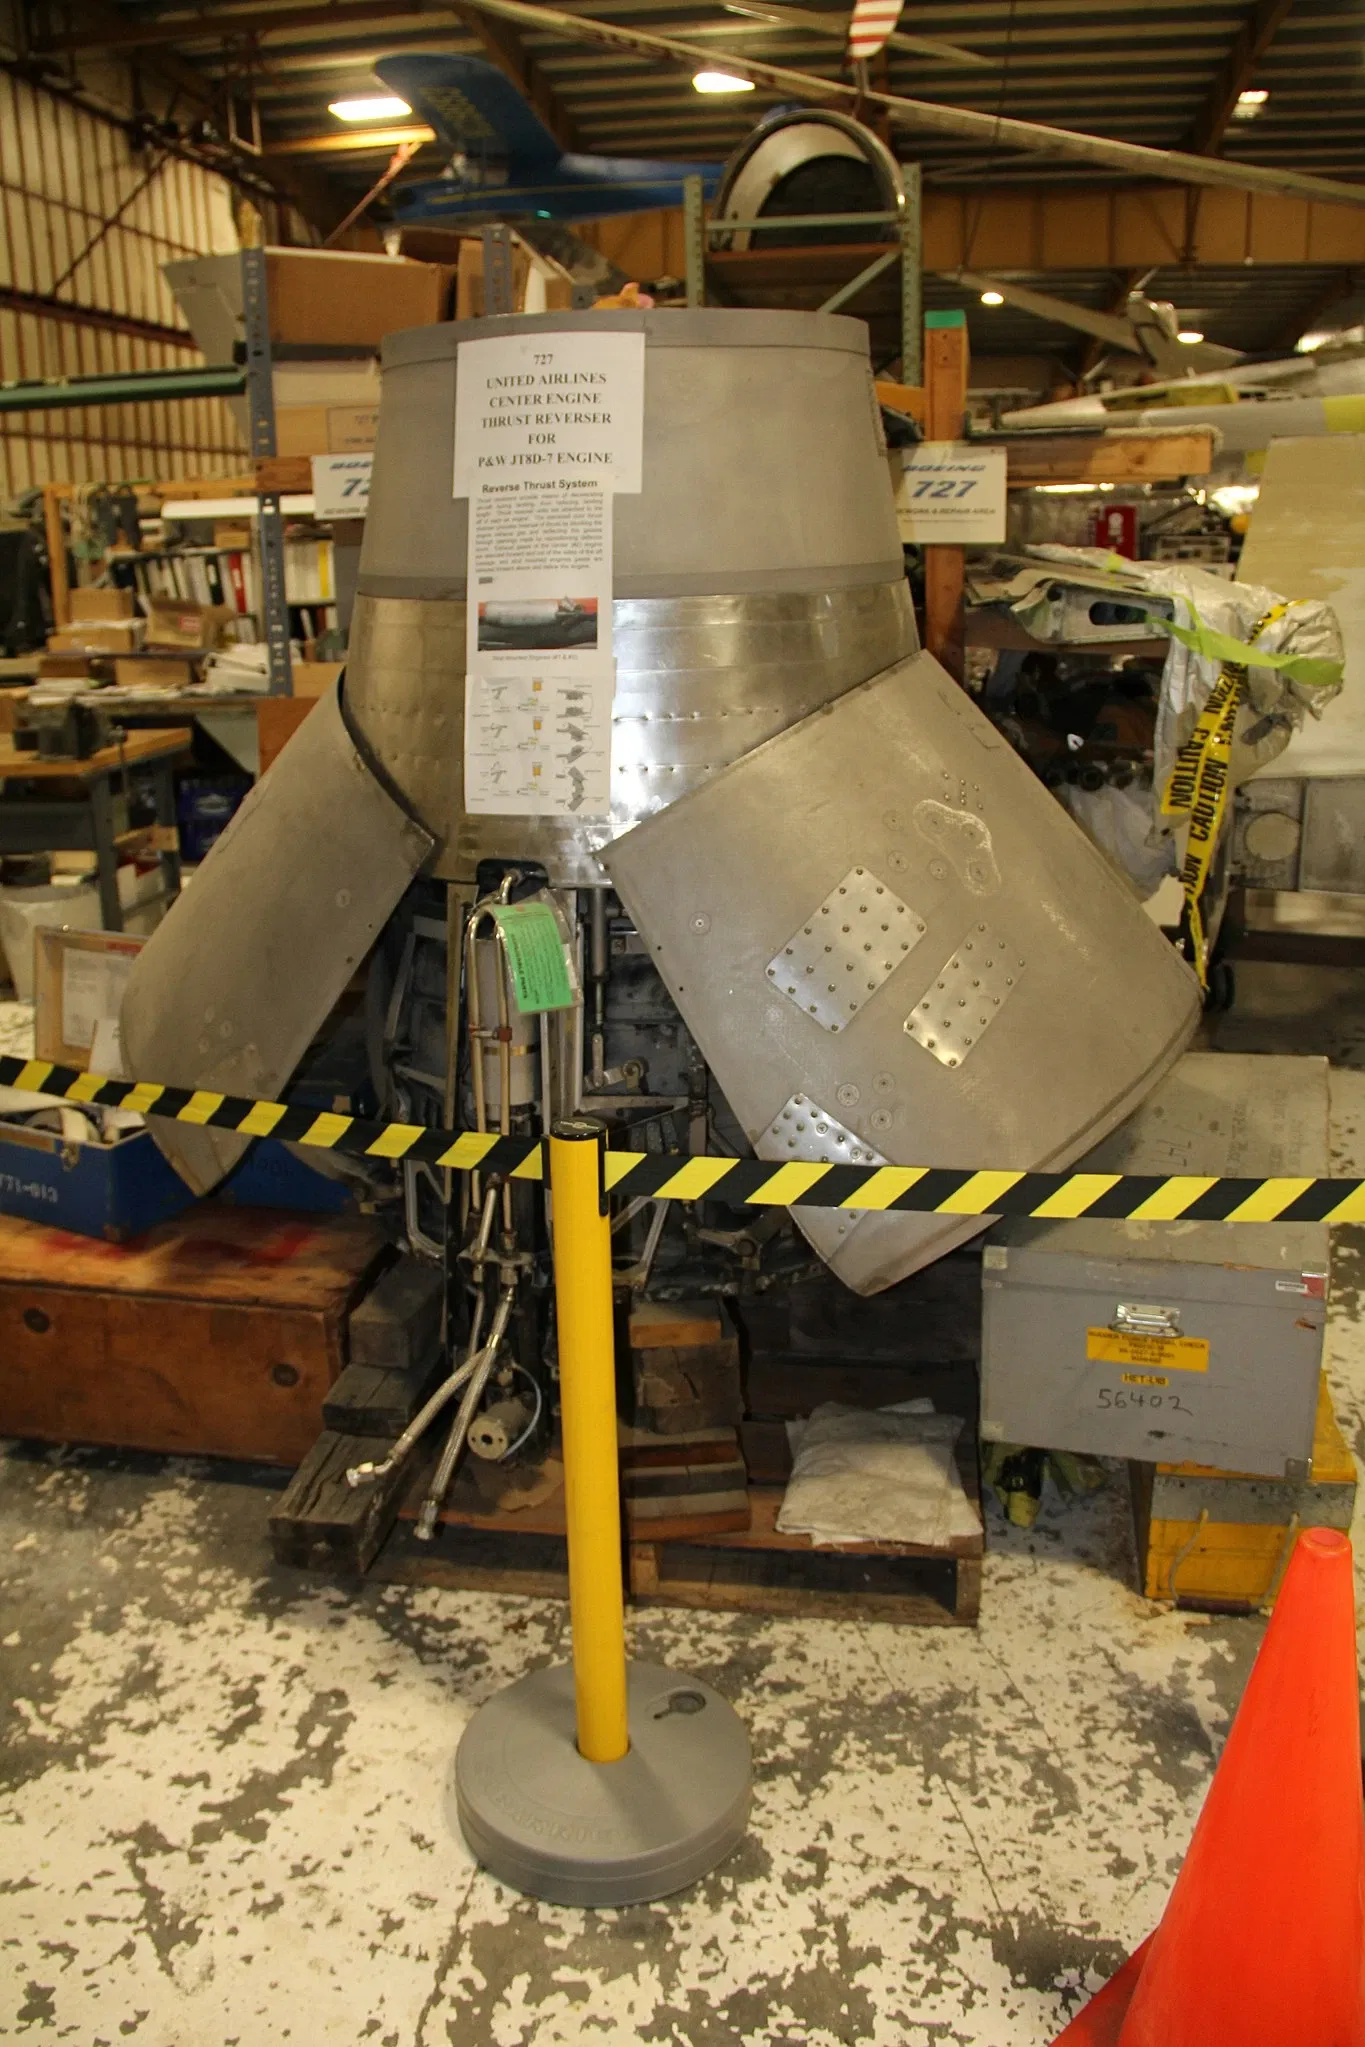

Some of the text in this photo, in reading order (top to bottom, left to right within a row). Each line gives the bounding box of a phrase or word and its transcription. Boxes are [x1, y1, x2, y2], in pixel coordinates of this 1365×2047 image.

[534, 354, 554, 364] 727
[486, 372, 607, 389] UNITED AIRLINES
[489, 393, 602, 408] CENTER ENGINE
[482, 412, 612, 428] THRUST REVERSER
[528, 433, 556, 444] FOR
[478, 452, 613, 467] P&W JT8D-7 ENGINE
[482, 479, 598, 493] Reverse Thrust System
[912, 480, 978, 498] 727
[1169, 727, 1209, 809] CAUTION
[1190, 758, 1228, 842] CAUTION
[1096, 1388, 1194, 1416] 56402
